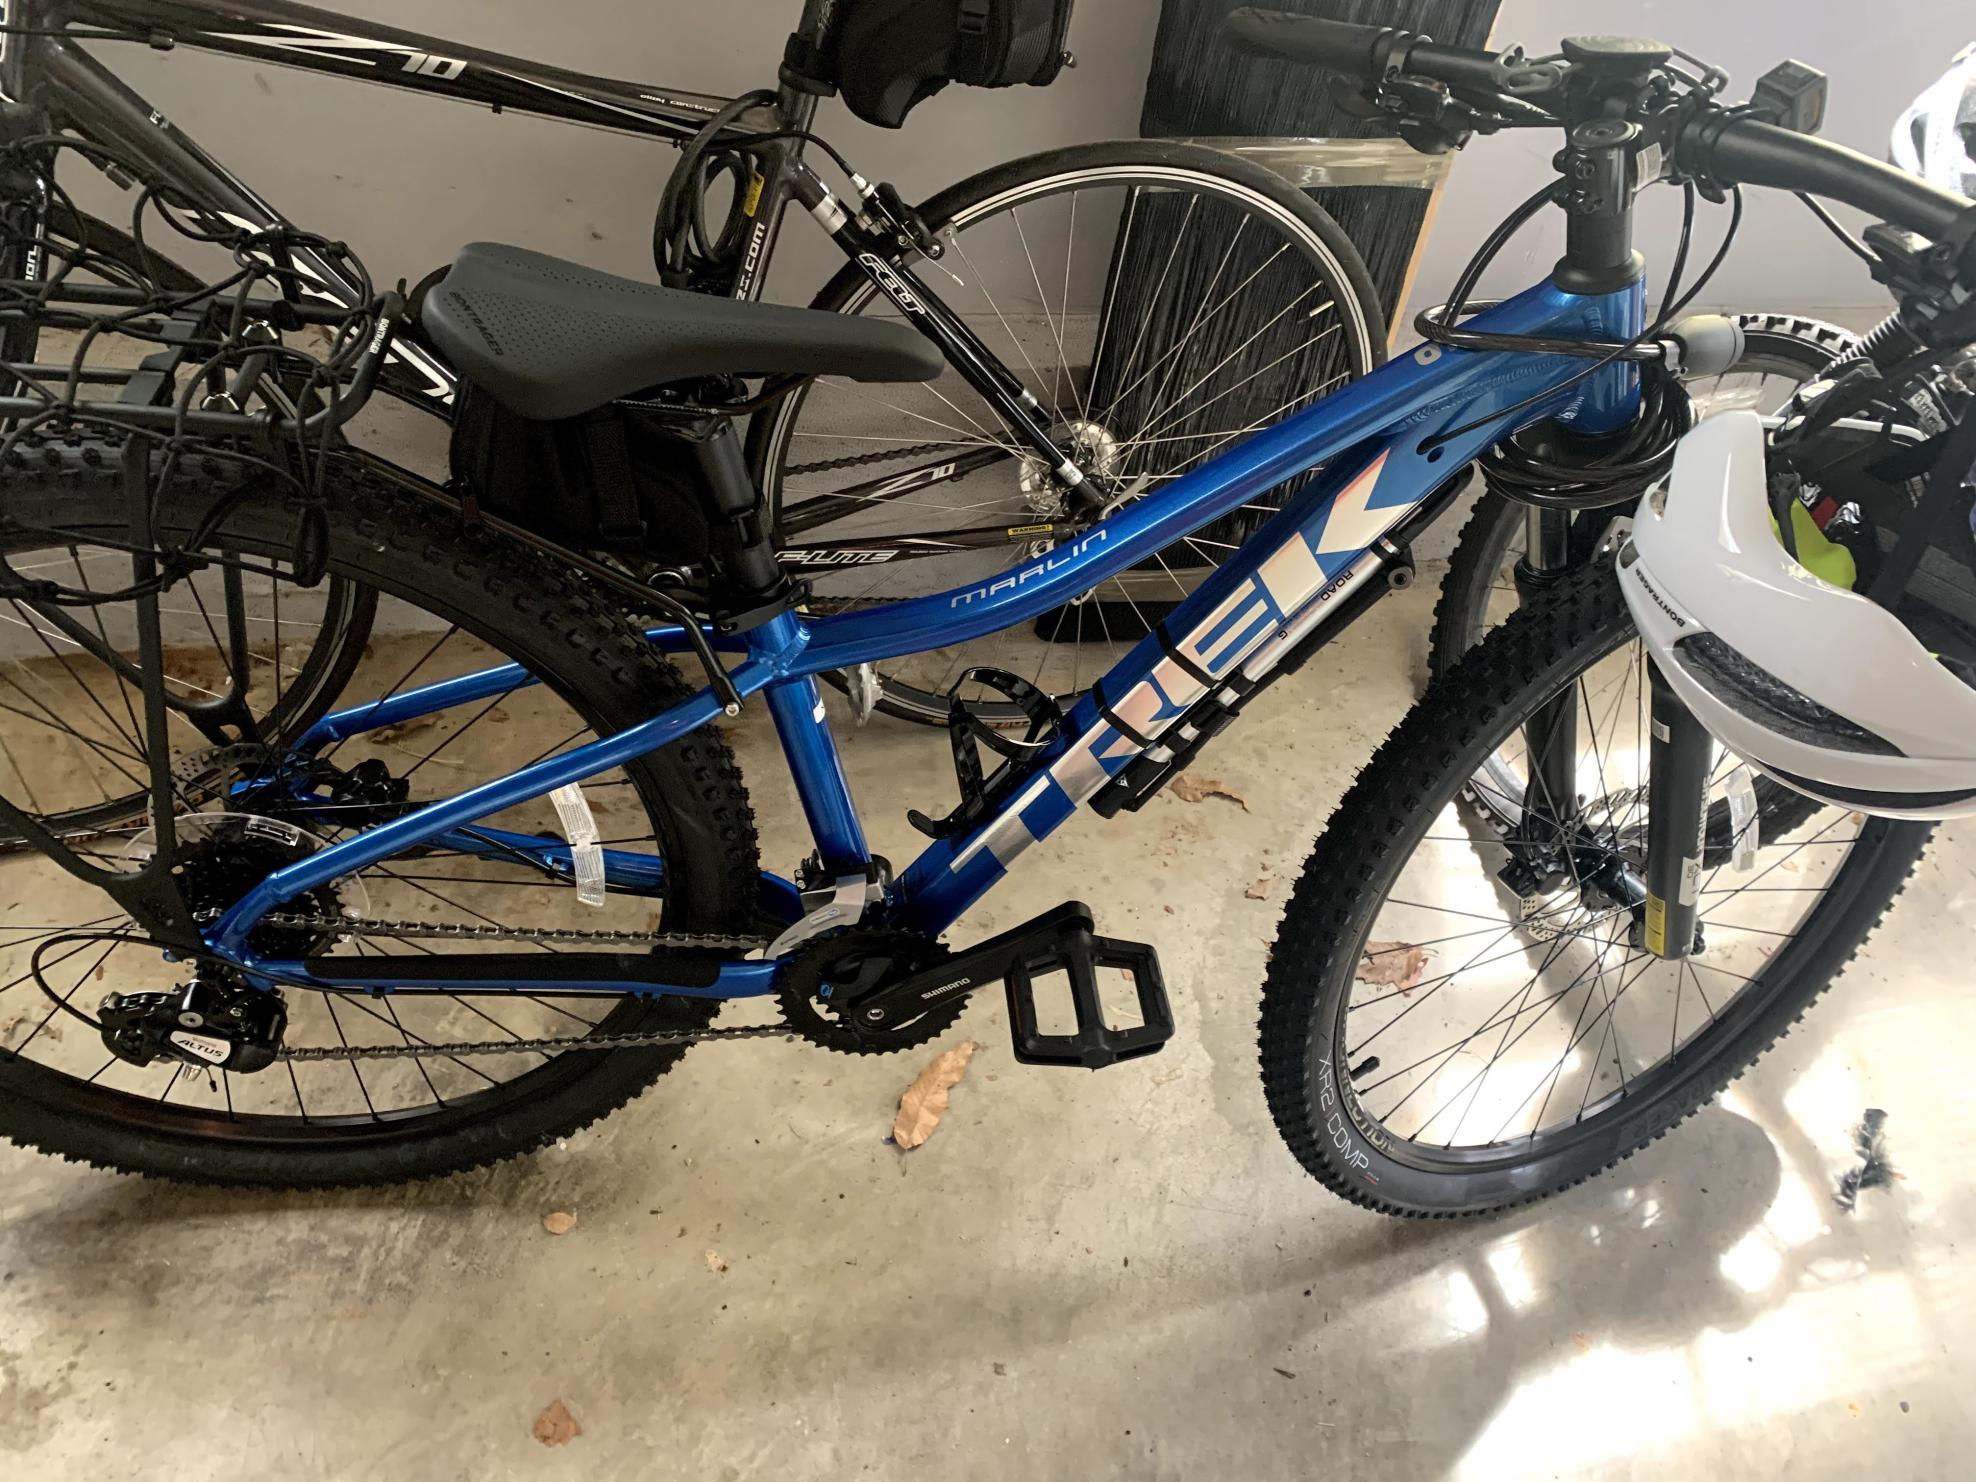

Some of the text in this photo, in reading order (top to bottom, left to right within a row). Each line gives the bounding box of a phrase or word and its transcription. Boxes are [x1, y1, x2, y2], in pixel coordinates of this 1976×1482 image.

[449, 291, 504, 356] BONTRAGER
[951, 529, 1107, 608] MARLIN
[1320, 570, 1354, 601] ROAD
[1635, 568, 1686, 627] BONTRAGER
[920, 977, 971, 1000] SHIMANO
[177, 1039, 224, 1057] ALTUS
[1327, 1112, 1369, 1169] COMP
